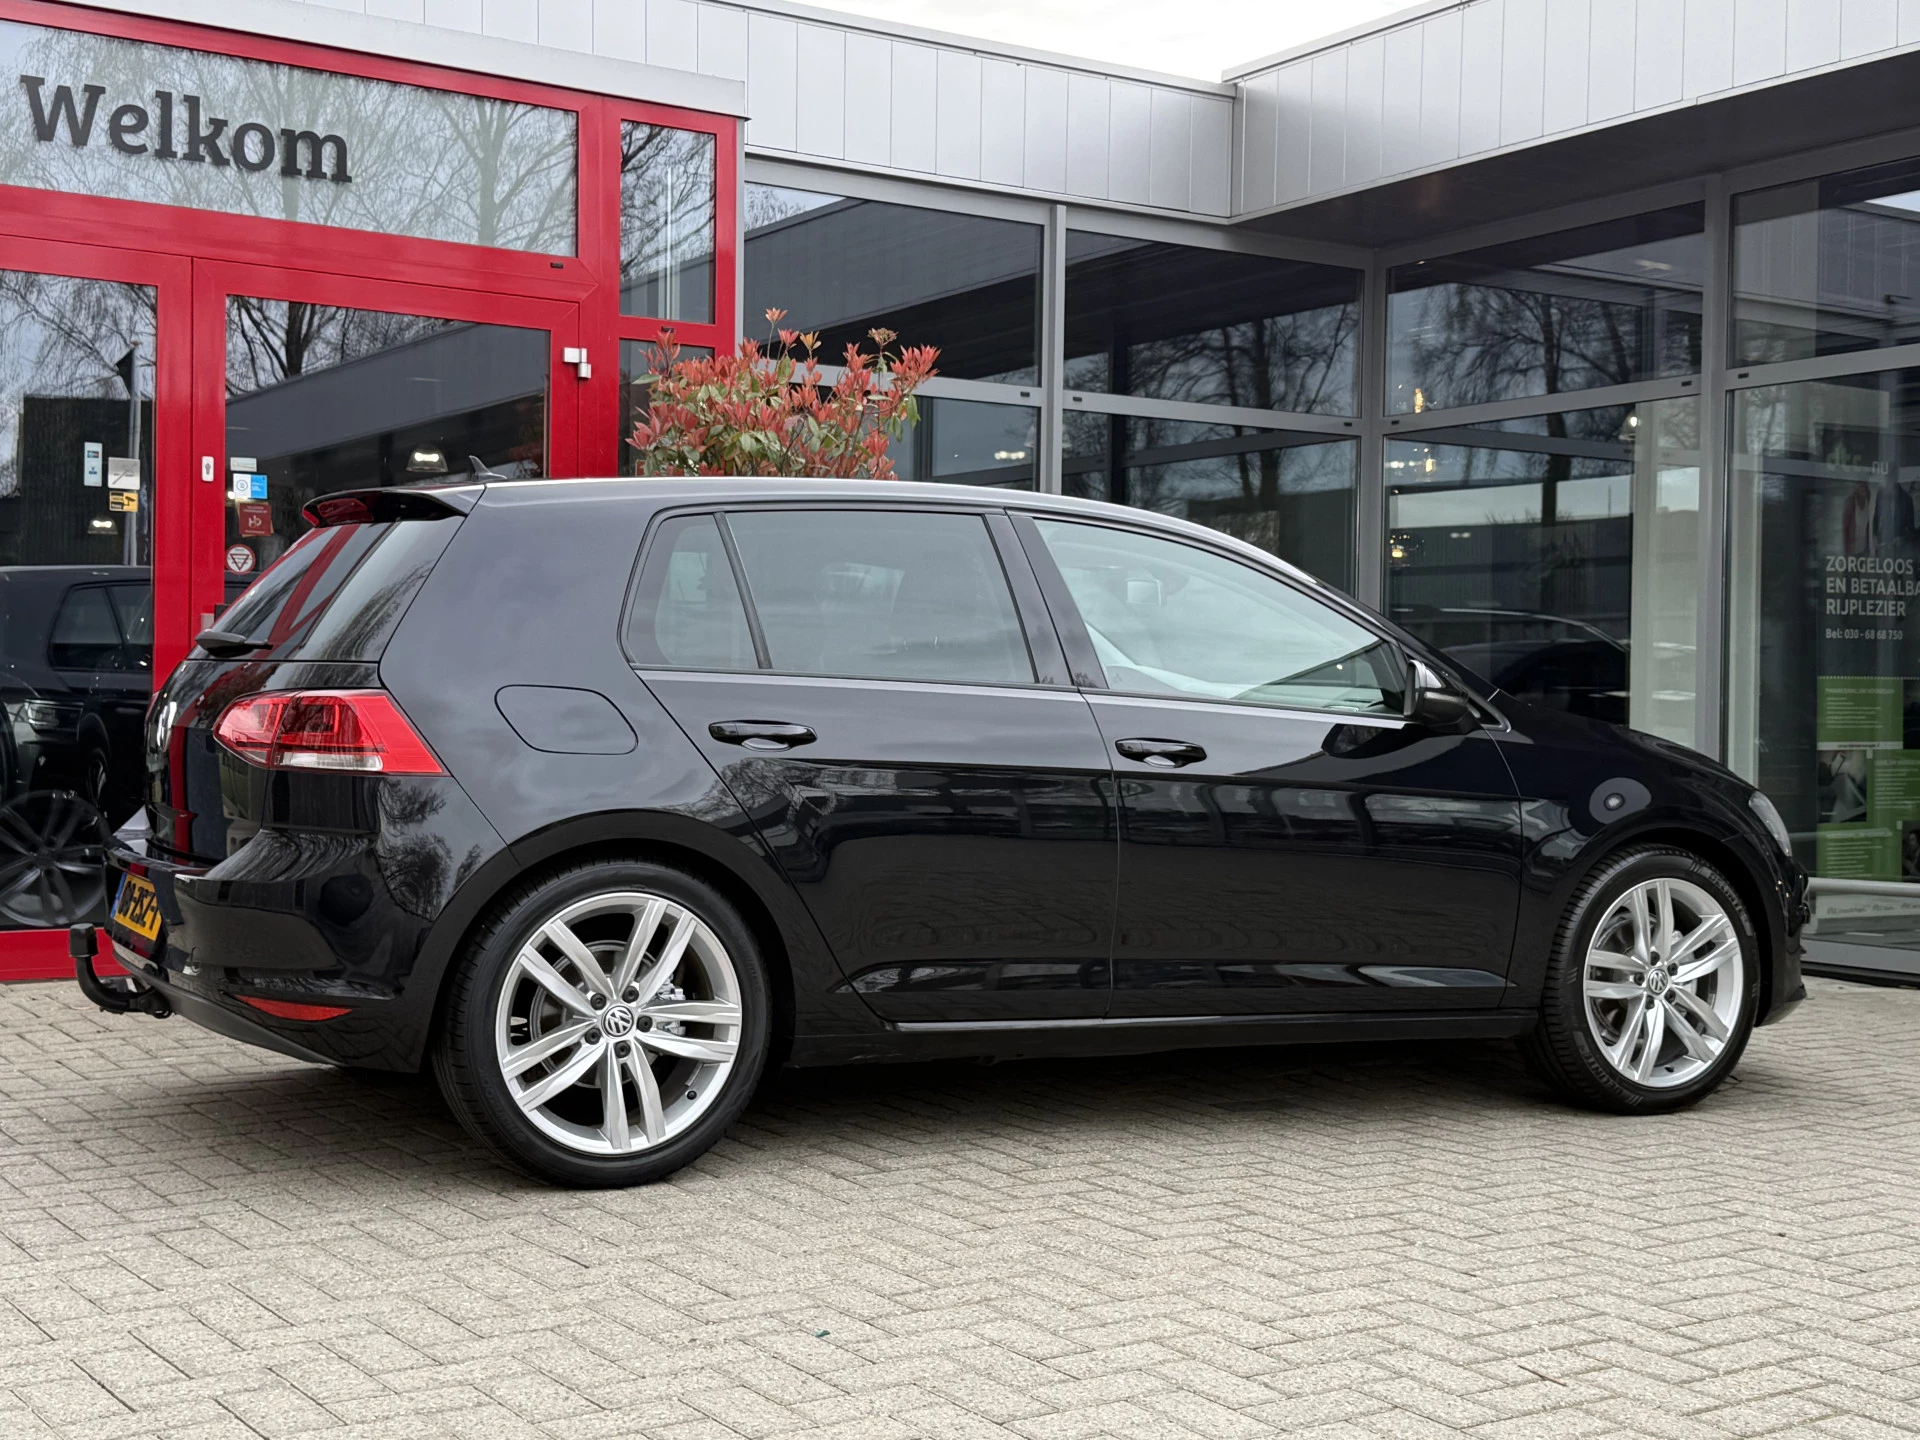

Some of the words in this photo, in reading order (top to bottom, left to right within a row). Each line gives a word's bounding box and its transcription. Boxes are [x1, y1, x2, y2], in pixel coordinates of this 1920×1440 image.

[20, 75, 352, 183] Welkom
[1826, 556, 1913, 575] ZORGELOOS
[1826, 577, 1846, 593] EN
[1826, 598, 1906, 617] RIJPLEZIER
